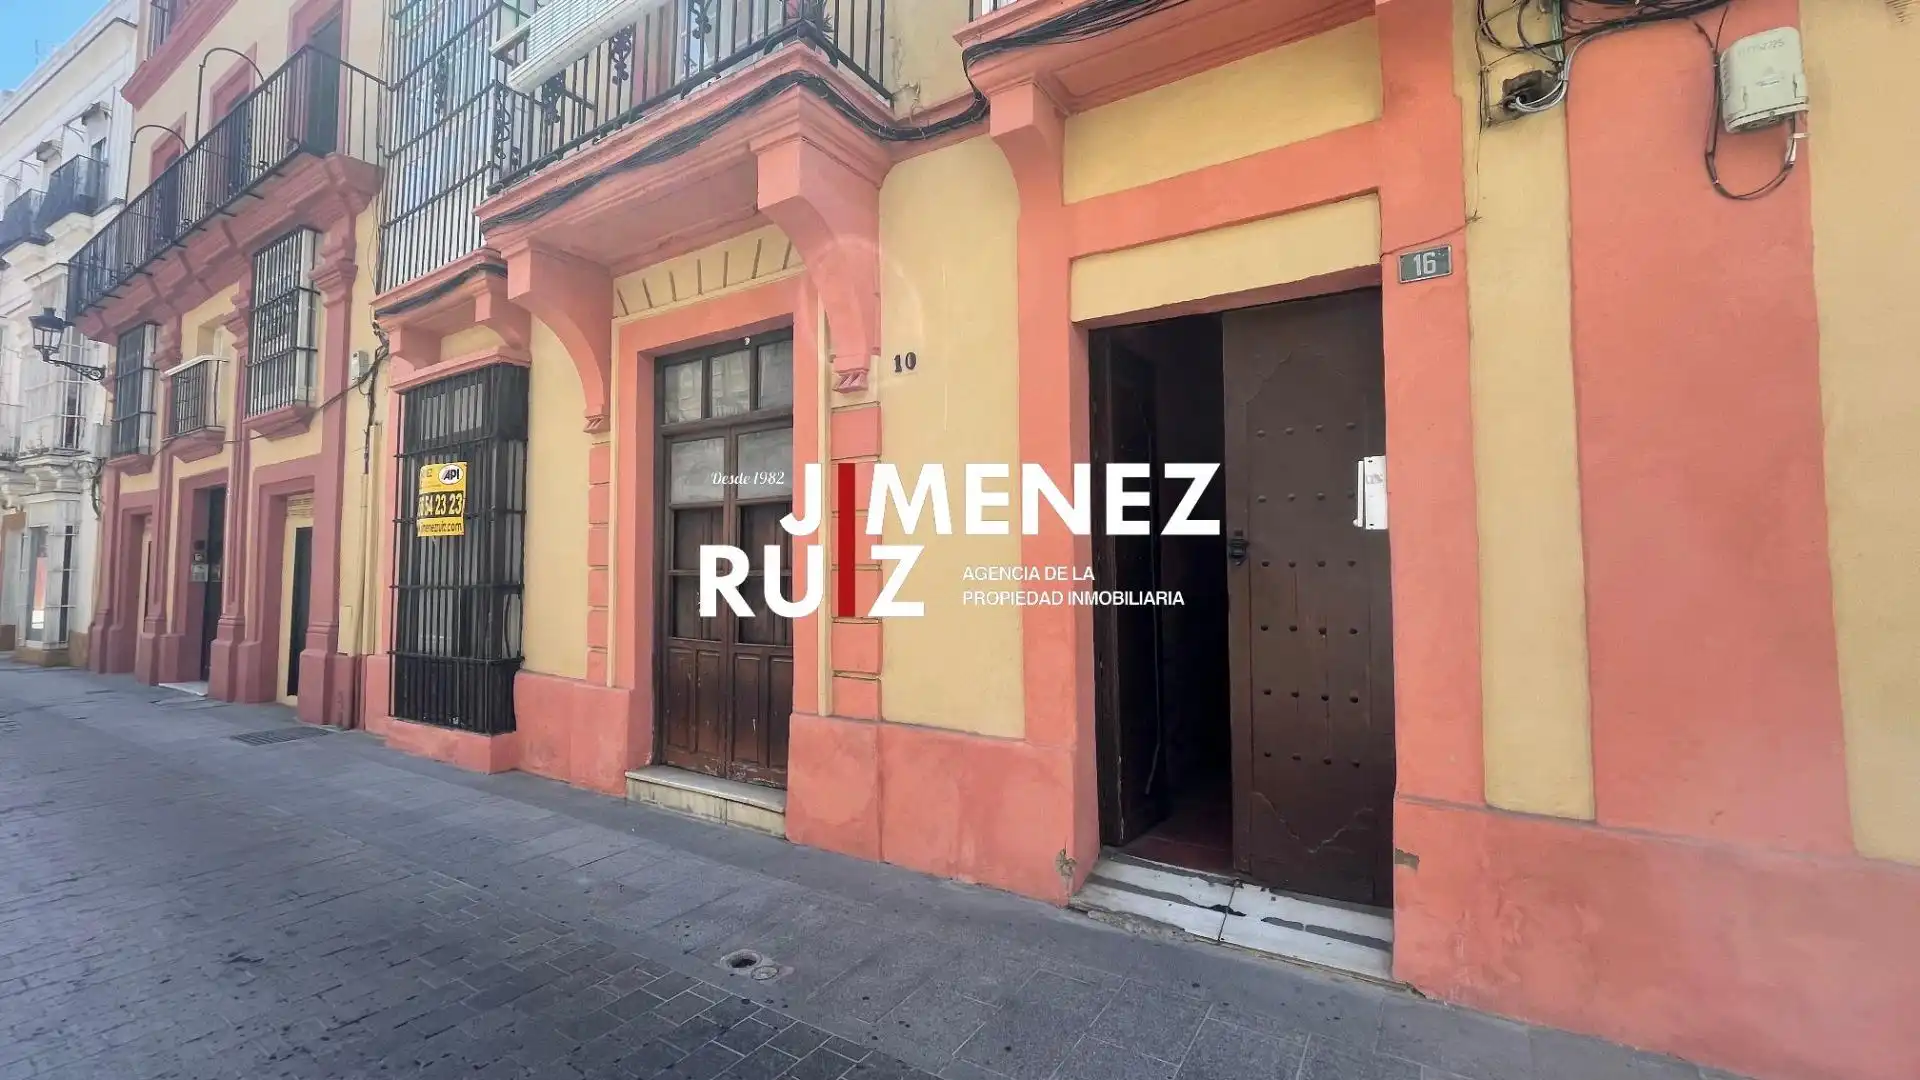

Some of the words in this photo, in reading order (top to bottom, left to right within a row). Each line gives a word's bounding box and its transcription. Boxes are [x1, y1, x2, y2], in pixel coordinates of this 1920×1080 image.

[1413, 251, 1436, 277] 16
[893, 351, 917, 373] 10
[443, 468, 460, 481] API
[435, 493, 447, 516] 23
[448, 492, 463, 515] 23
